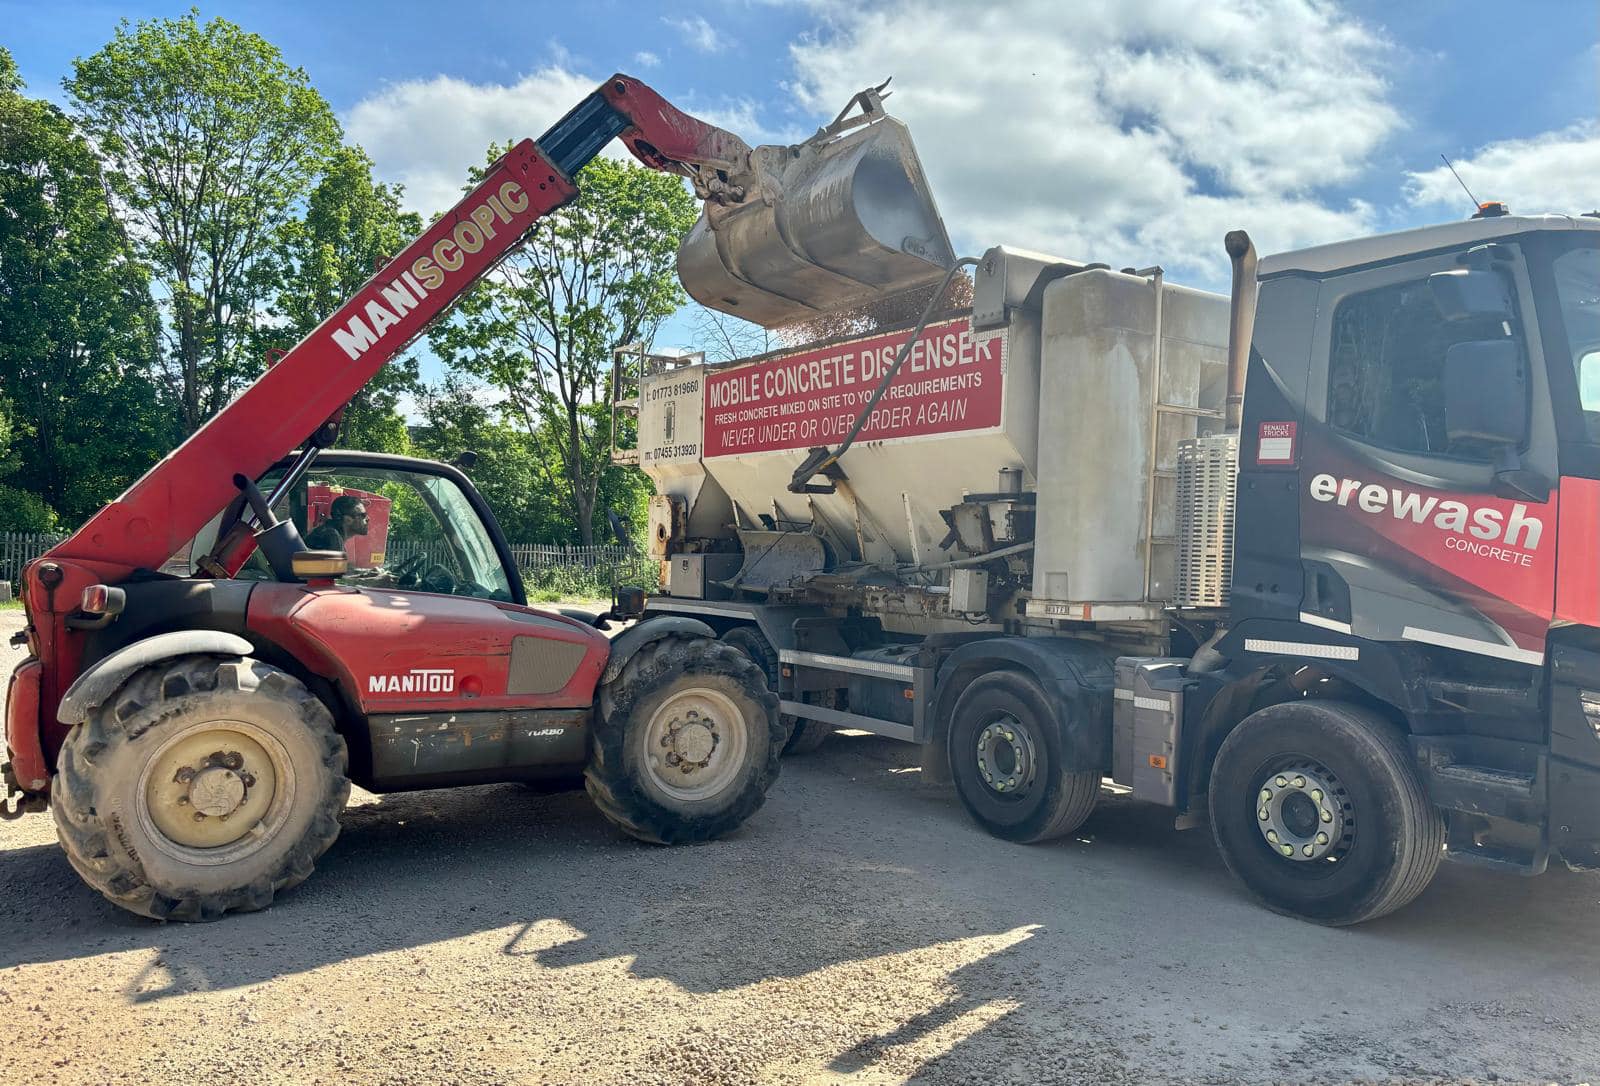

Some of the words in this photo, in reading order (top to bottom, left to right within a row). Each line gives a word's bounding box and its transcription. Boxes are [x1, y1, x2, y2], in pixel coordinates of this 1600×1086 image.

[330, 181, 529, 361] MANISCOPIC
[652, 387, 672, 400] 01773
[674, 380, 699, 396] 819660
[710, 373, 760, 408] MOBILE
[764, 353, 855, 398] CONCRETE
[715, 411, 737, 425] FRESH
[739, 405, 778, 421] CONCRETE
[780, 401, 806, 415] MIXED
[808, 399, 820, 411] ON
[822, 394, 840, 409] SITE
[842, 392, 856, 406] TO
[858, 389, 887, 404] YOR
[890, 371, 982, 399] REQUIREMENTS
[721, 427, 755, 447] NEVER
[758, 421, 796, 443] UNDER
[800, 418, 818, 438] OR
[822, 413, 855, 439] OVER
[915, 398, 968, 425] AGAIN
[653, 446, 672, 460] 07455
[674, 444, 697, 458] 313920
[1309, 472, 1544, 550] erewash
[1445, 536, 1534, 567] CONCRETE
[368, 669, 455, 693] MANITOU
